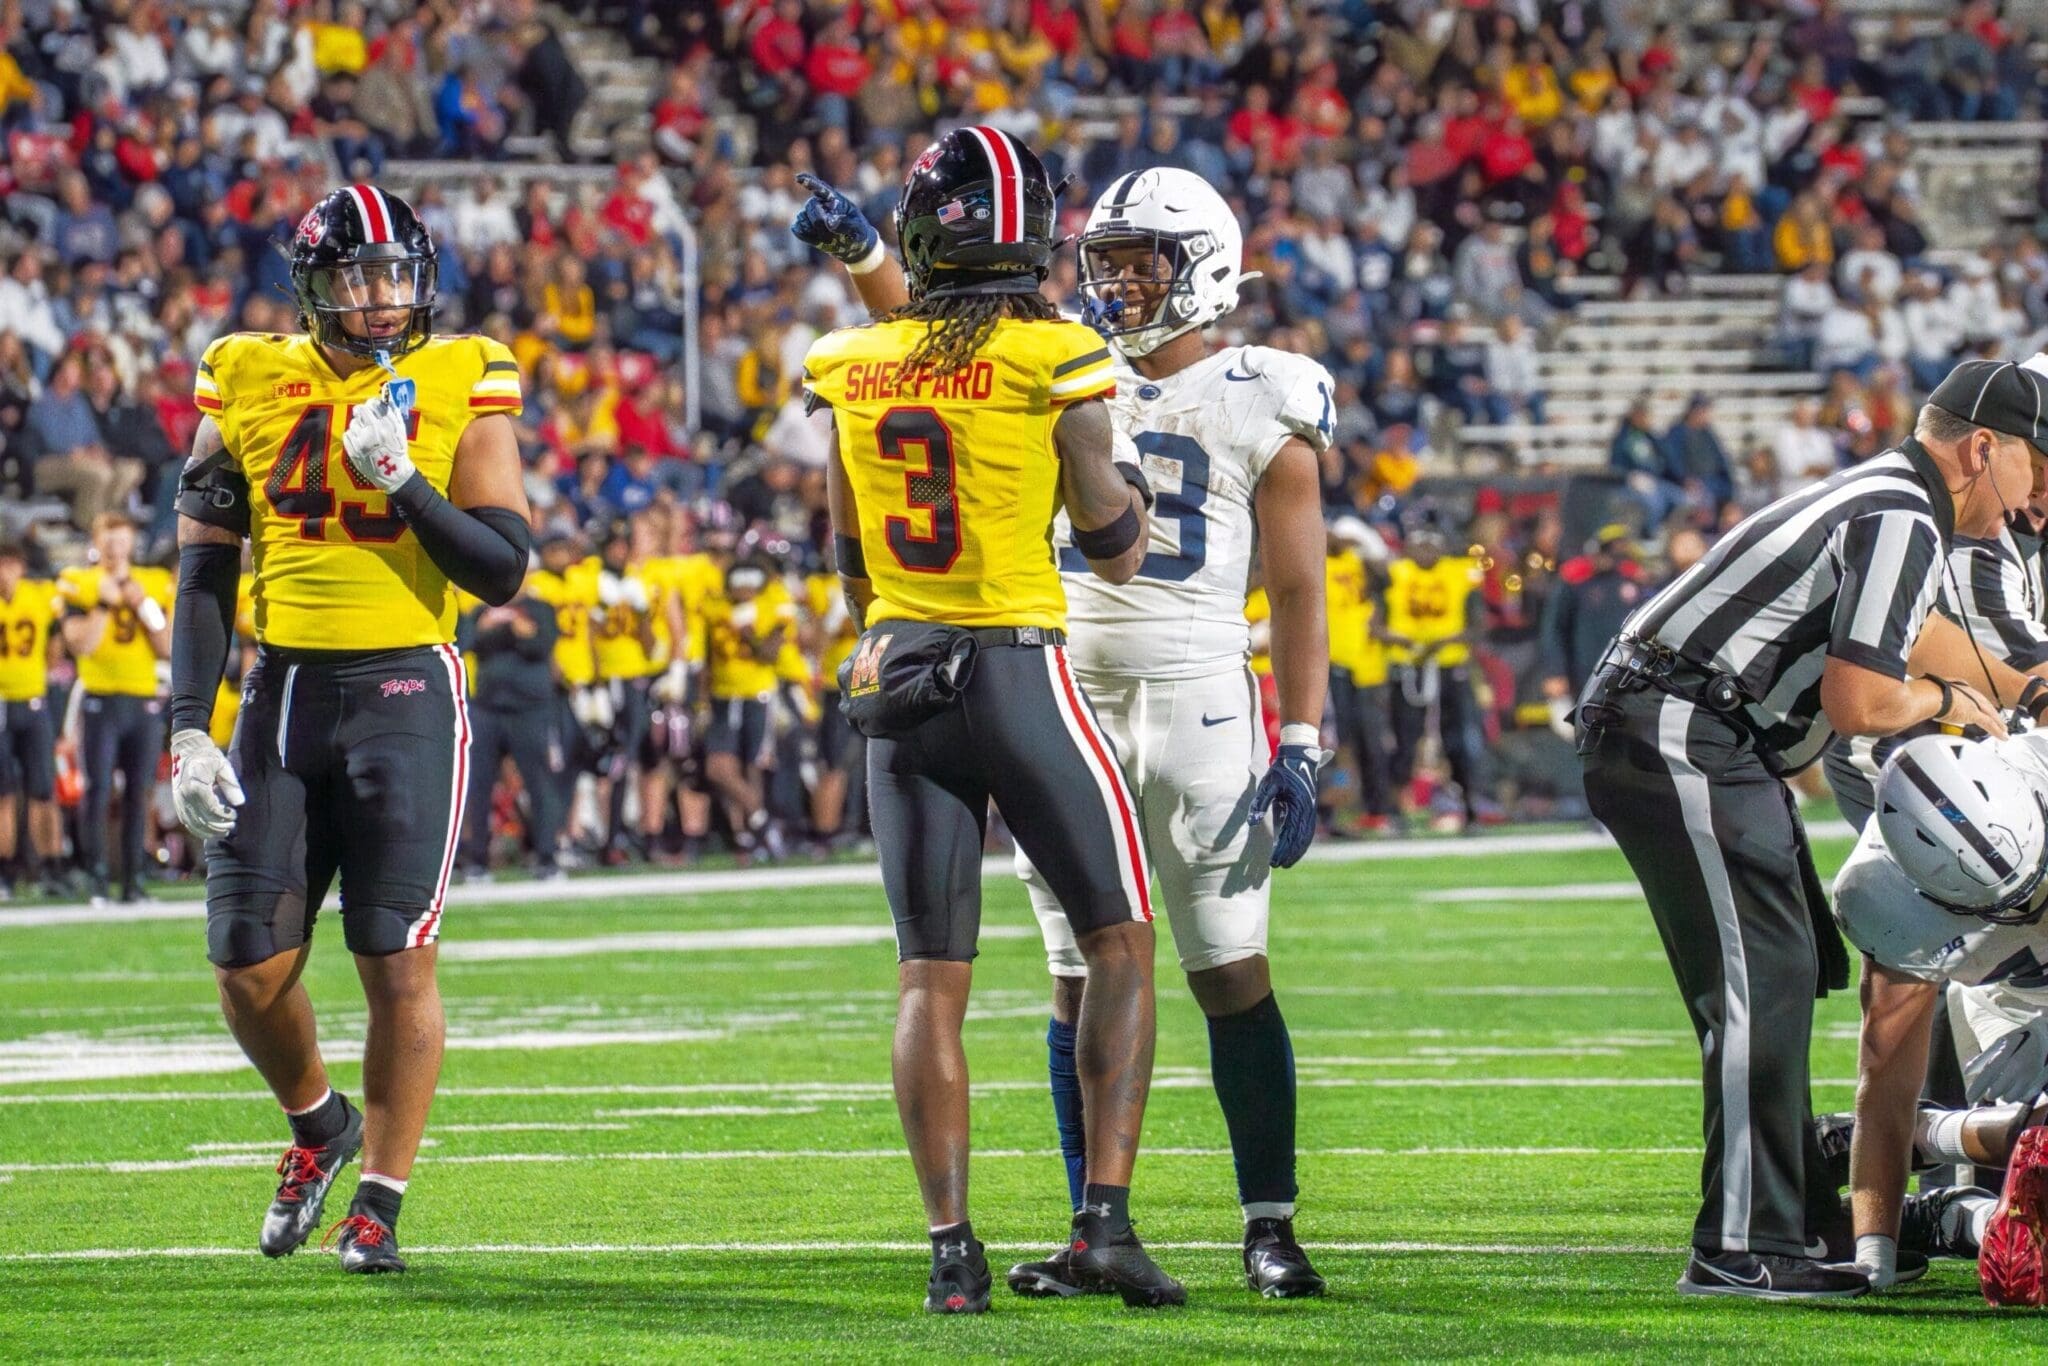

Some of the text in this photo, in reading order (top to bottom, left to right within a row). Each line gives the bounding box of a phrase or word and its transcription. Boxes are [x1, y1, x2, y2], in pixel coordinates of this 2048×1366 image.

[845, 361, 994, 401] SHEPPARD
[875, 406, 963, 574] 3
[380, 678, 426, 698] Terps
